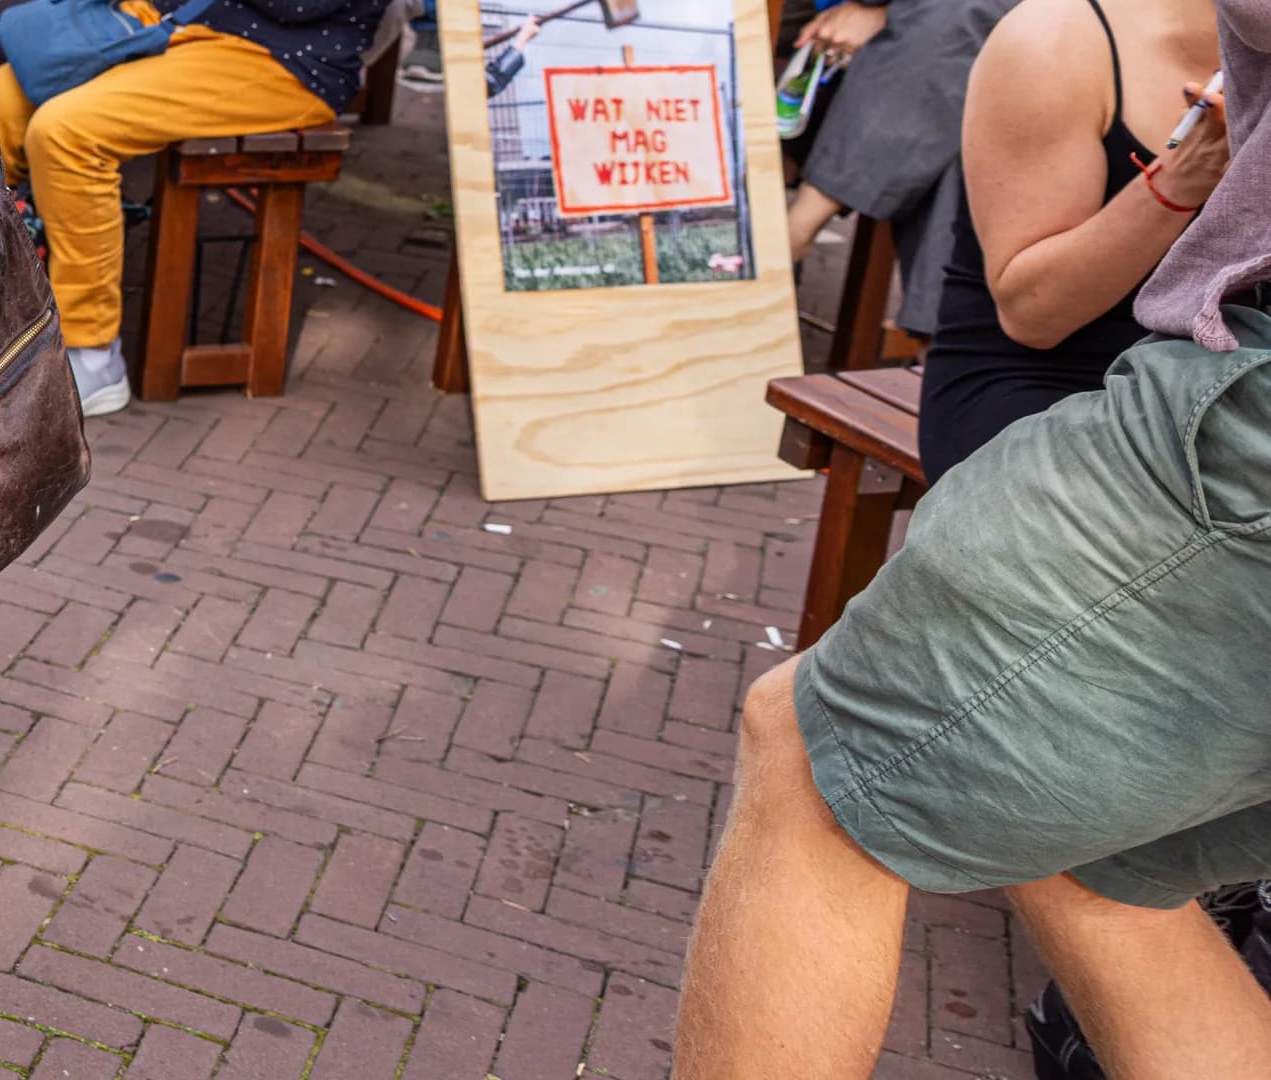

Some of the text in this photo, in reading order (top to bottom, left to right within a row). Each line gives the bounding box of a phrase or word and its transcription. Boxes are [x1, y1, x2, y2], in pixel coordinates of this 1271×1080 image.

[568, 98, 701, 122] WAT NIET
[610, 129, 667, 154] MAG
[593, 161, 689, 185] WIJKEN
